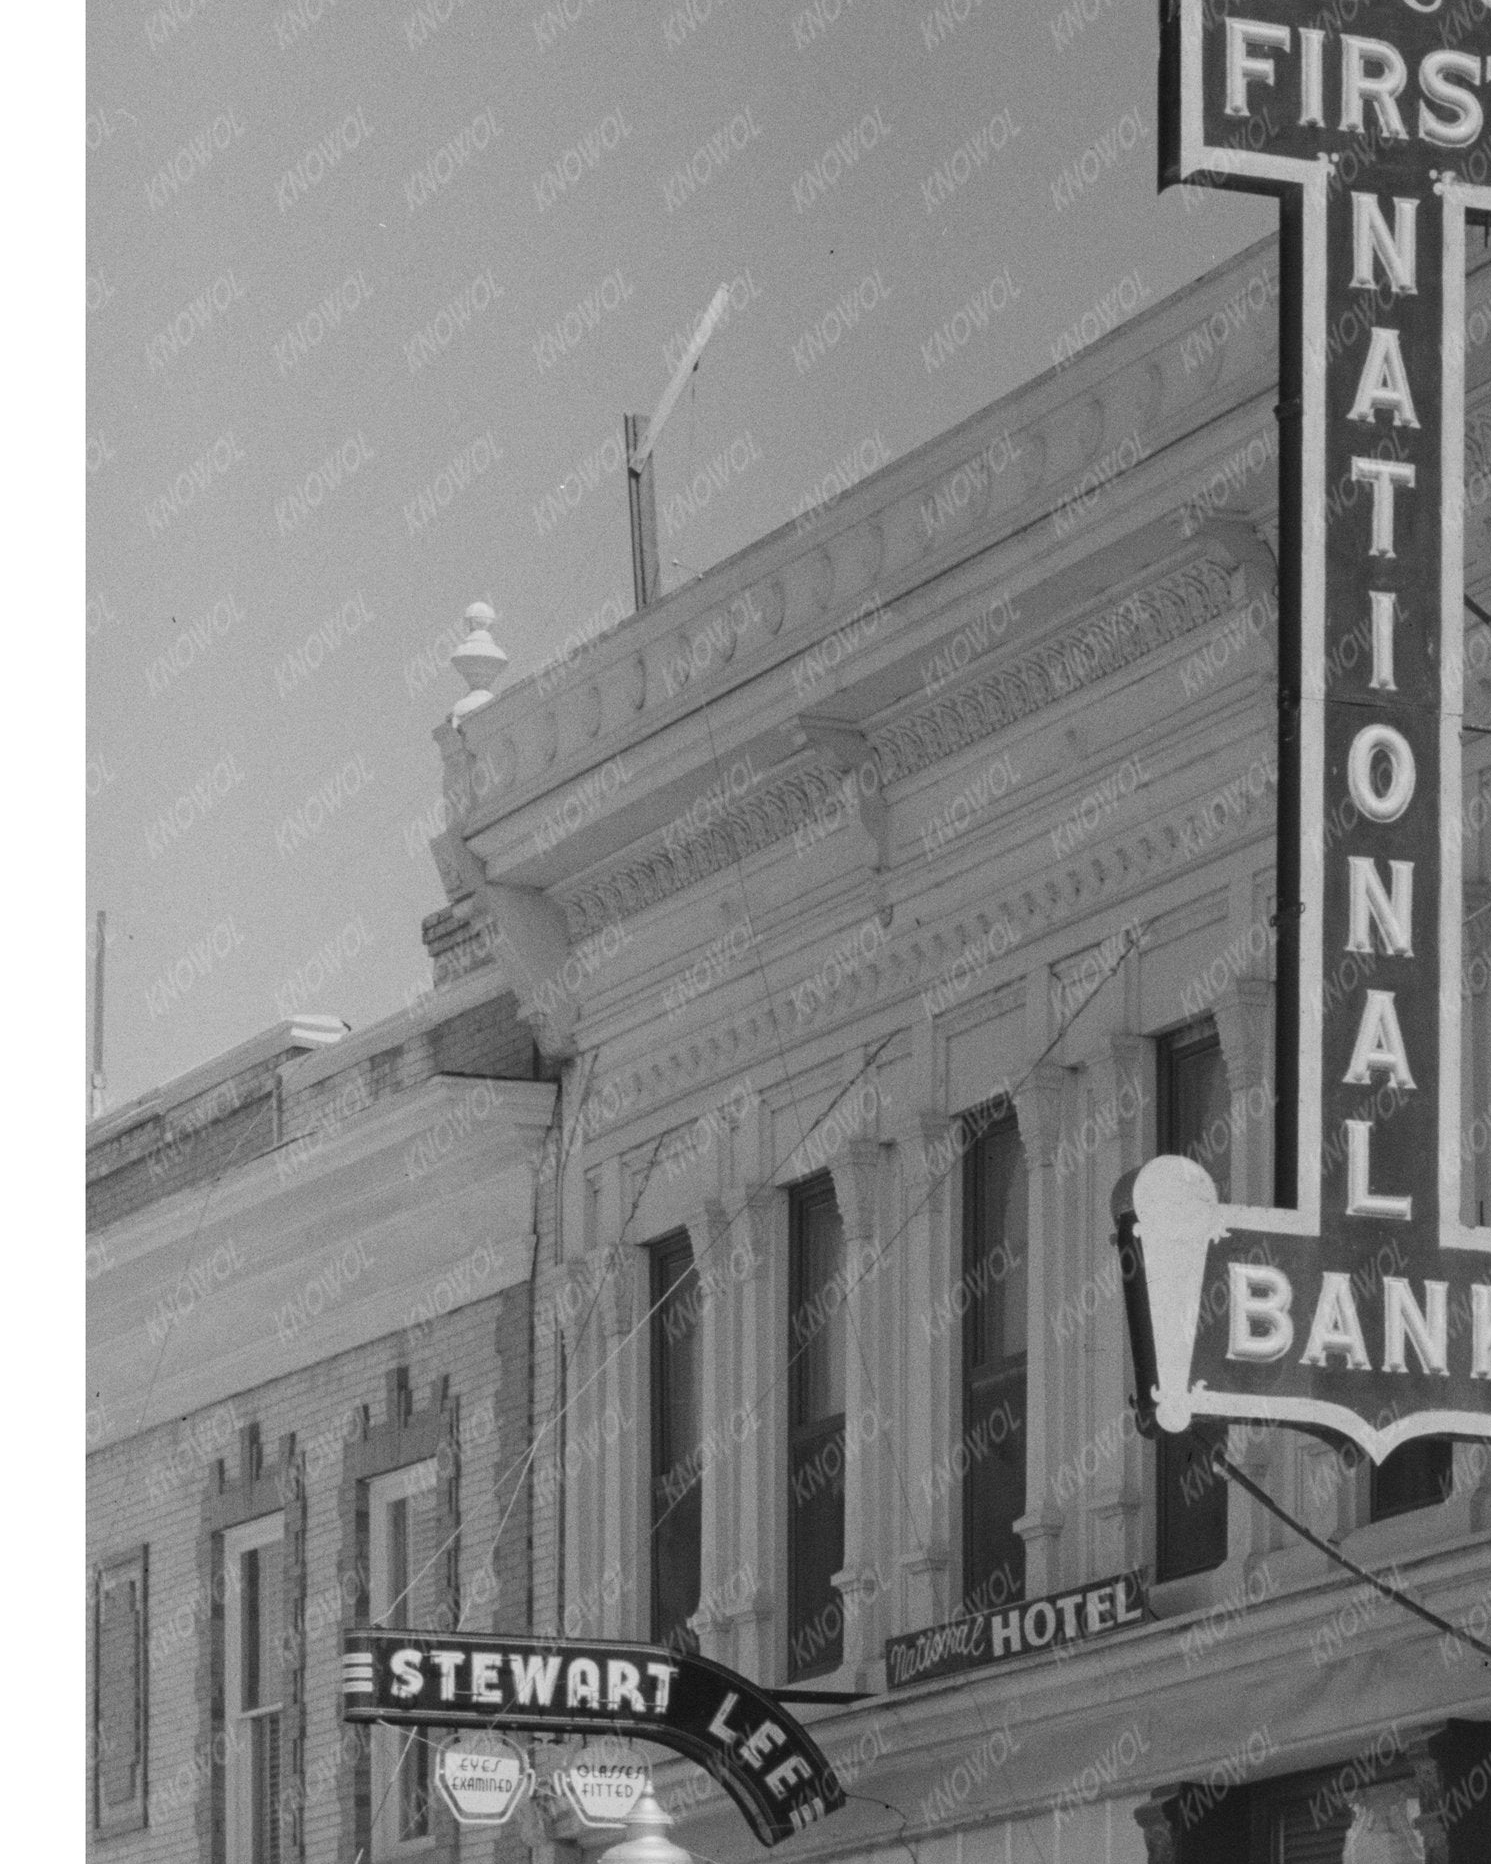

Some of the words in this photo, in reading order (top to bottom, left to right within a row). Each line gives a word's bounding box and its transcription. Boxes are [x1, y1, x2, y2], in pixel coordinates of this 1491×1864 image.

[1341, 191, 1420, 1221] NATIONAL
[890, 1615, 986, 1684] National
[991, 1581, 1143, 1658] HOTEL
[389, 1648, 679, 1714] STEWART
[707, 1691, 812, 1800] LEE
[452, 1776, 514, 1793] EXAMINED
[460, 1757, 502, 1773] EYES
[582, 1783, 634, 1798] FITTED
